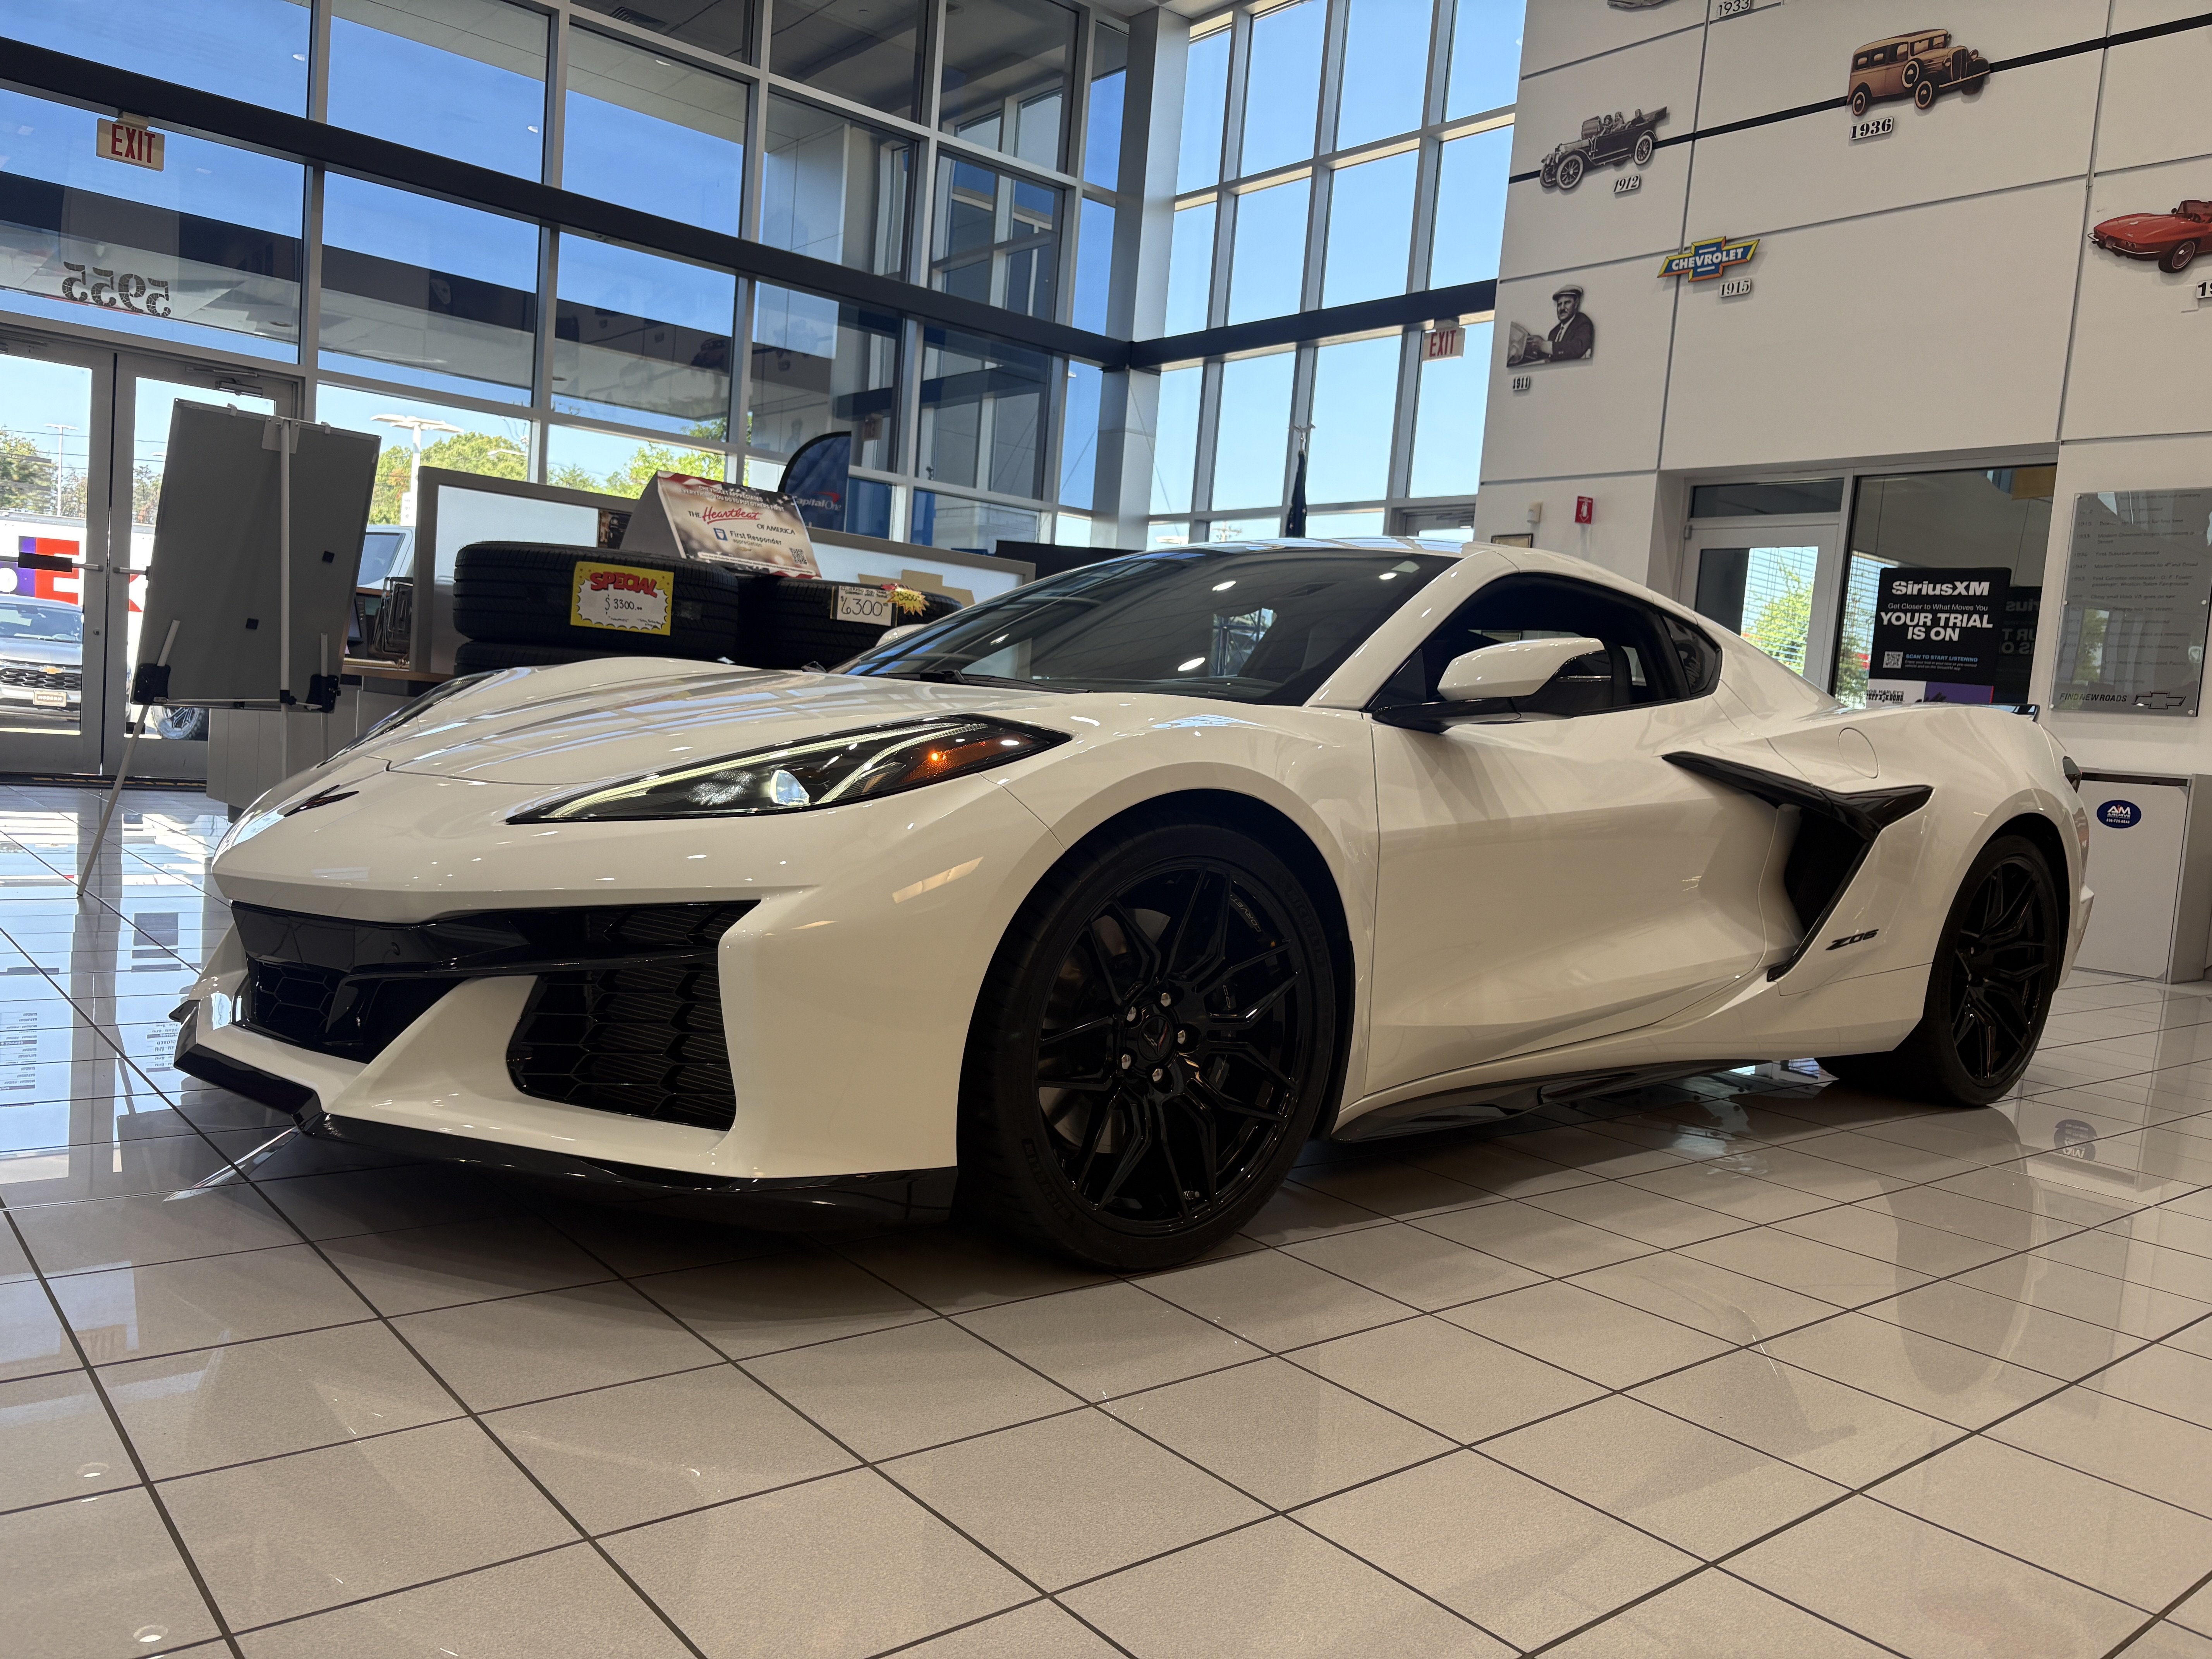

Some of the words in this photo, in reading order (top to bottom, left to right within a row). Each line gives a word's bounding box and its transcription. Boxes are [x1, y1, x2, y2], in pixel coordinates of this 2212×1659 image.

[1718, 0, 1750, 16] 1933
[1850, 117, 1893, 139] 1936
[111, 124, 156, 163] EXIT
[1613, 175, 1639, 192] 1912
[1671, 247, 1744, 271] CHEVROLET
[1720, 280, 1750, 296] 1915
[1429, 330, 1456, 357] EXIT
[1513, 377, 1529, 390] 1911
[702, 506, 763, 522] Heartbeat
[730, 531, 746, 539] First
[747, 534, 781, 545] Responder
[766, 524, 795, 535] AMERICA
[590, 571, 658, 599] SPECIAL
[1892, 581, 1990, 596] SiriusXM
[1880, 611, 1932, 626] YOUR
[1937, 613, 1993, 628] TRIAL
[1907, 627, 1926, 640] IS
[1930, 627, 1960, 642] ON
[1230, 894, 1262, 933] CORVET
[1826, 929, 1879, 951] Z06
